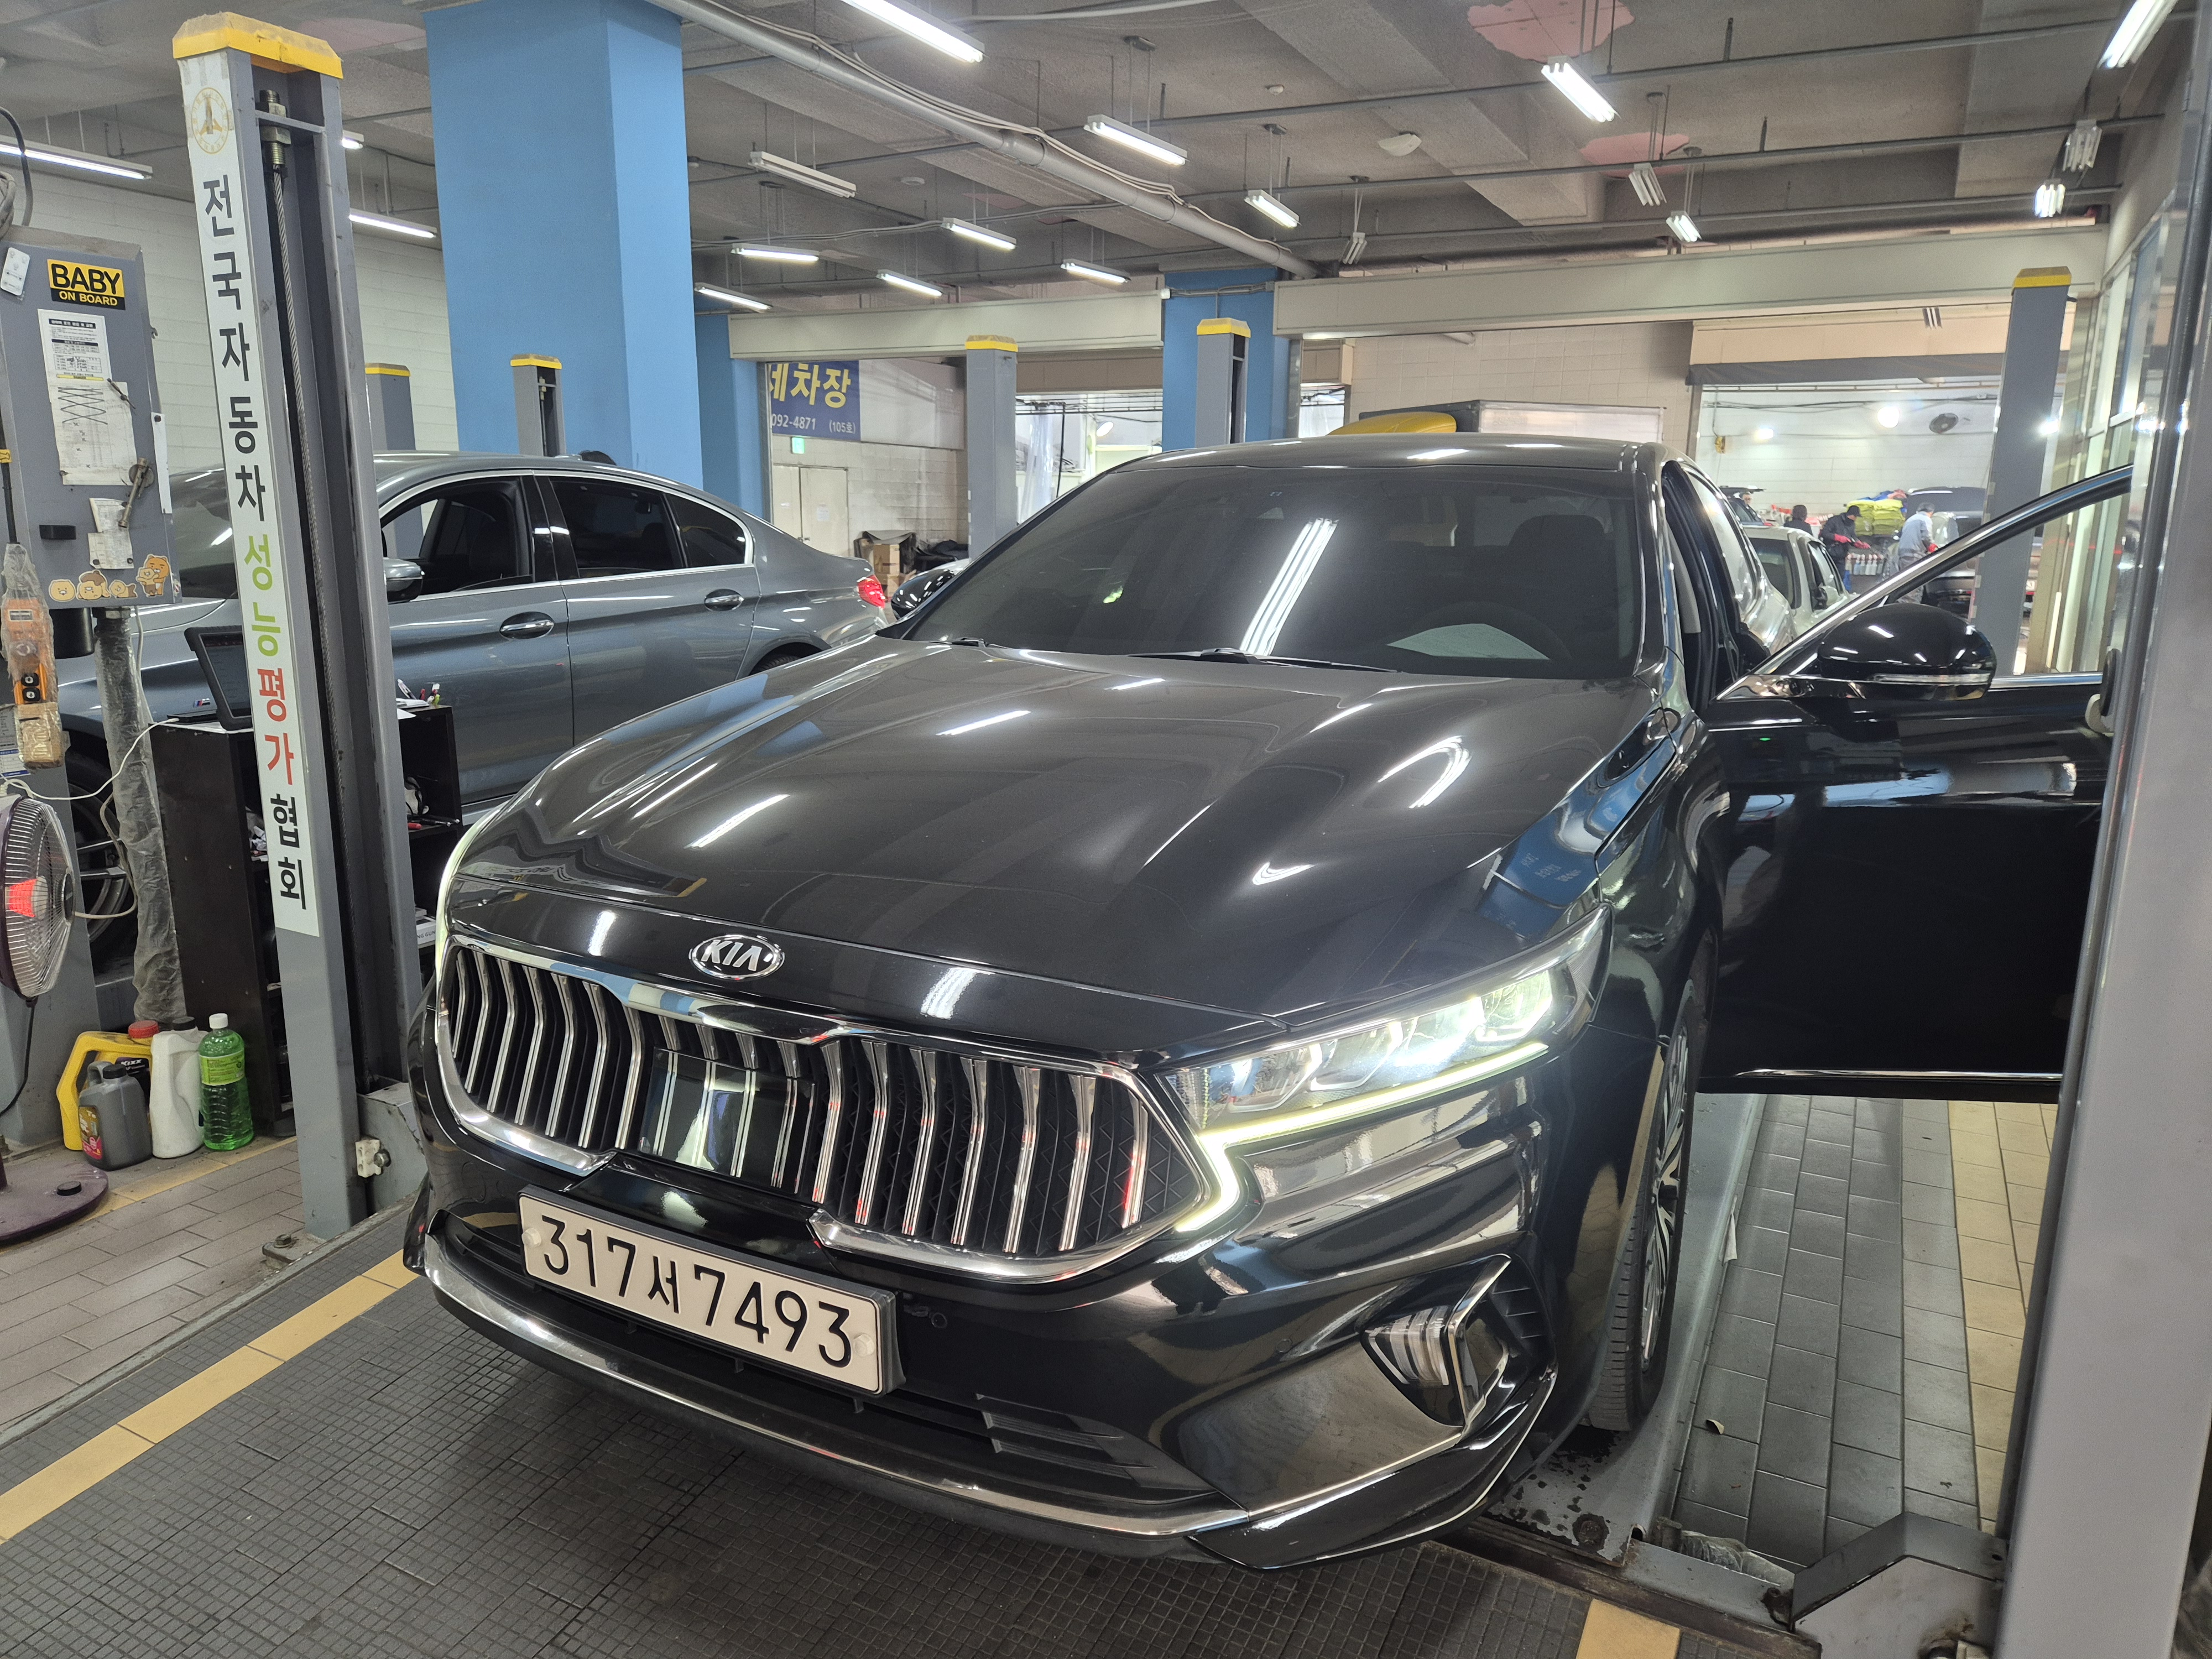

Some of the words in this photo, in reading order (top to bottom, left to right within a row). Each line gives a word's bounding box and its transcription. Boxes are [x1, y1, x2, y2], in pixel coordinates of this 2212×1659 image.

[51, 263, 121, 295] BABY
[59, 290, 76, 301] ON
[79, 293, 118, 306] BOARD
[829, 419, 856, 435] (105호)
[701, 940, 763, 972] KIA
[541, 1214, 852, 1369] 317서7493
